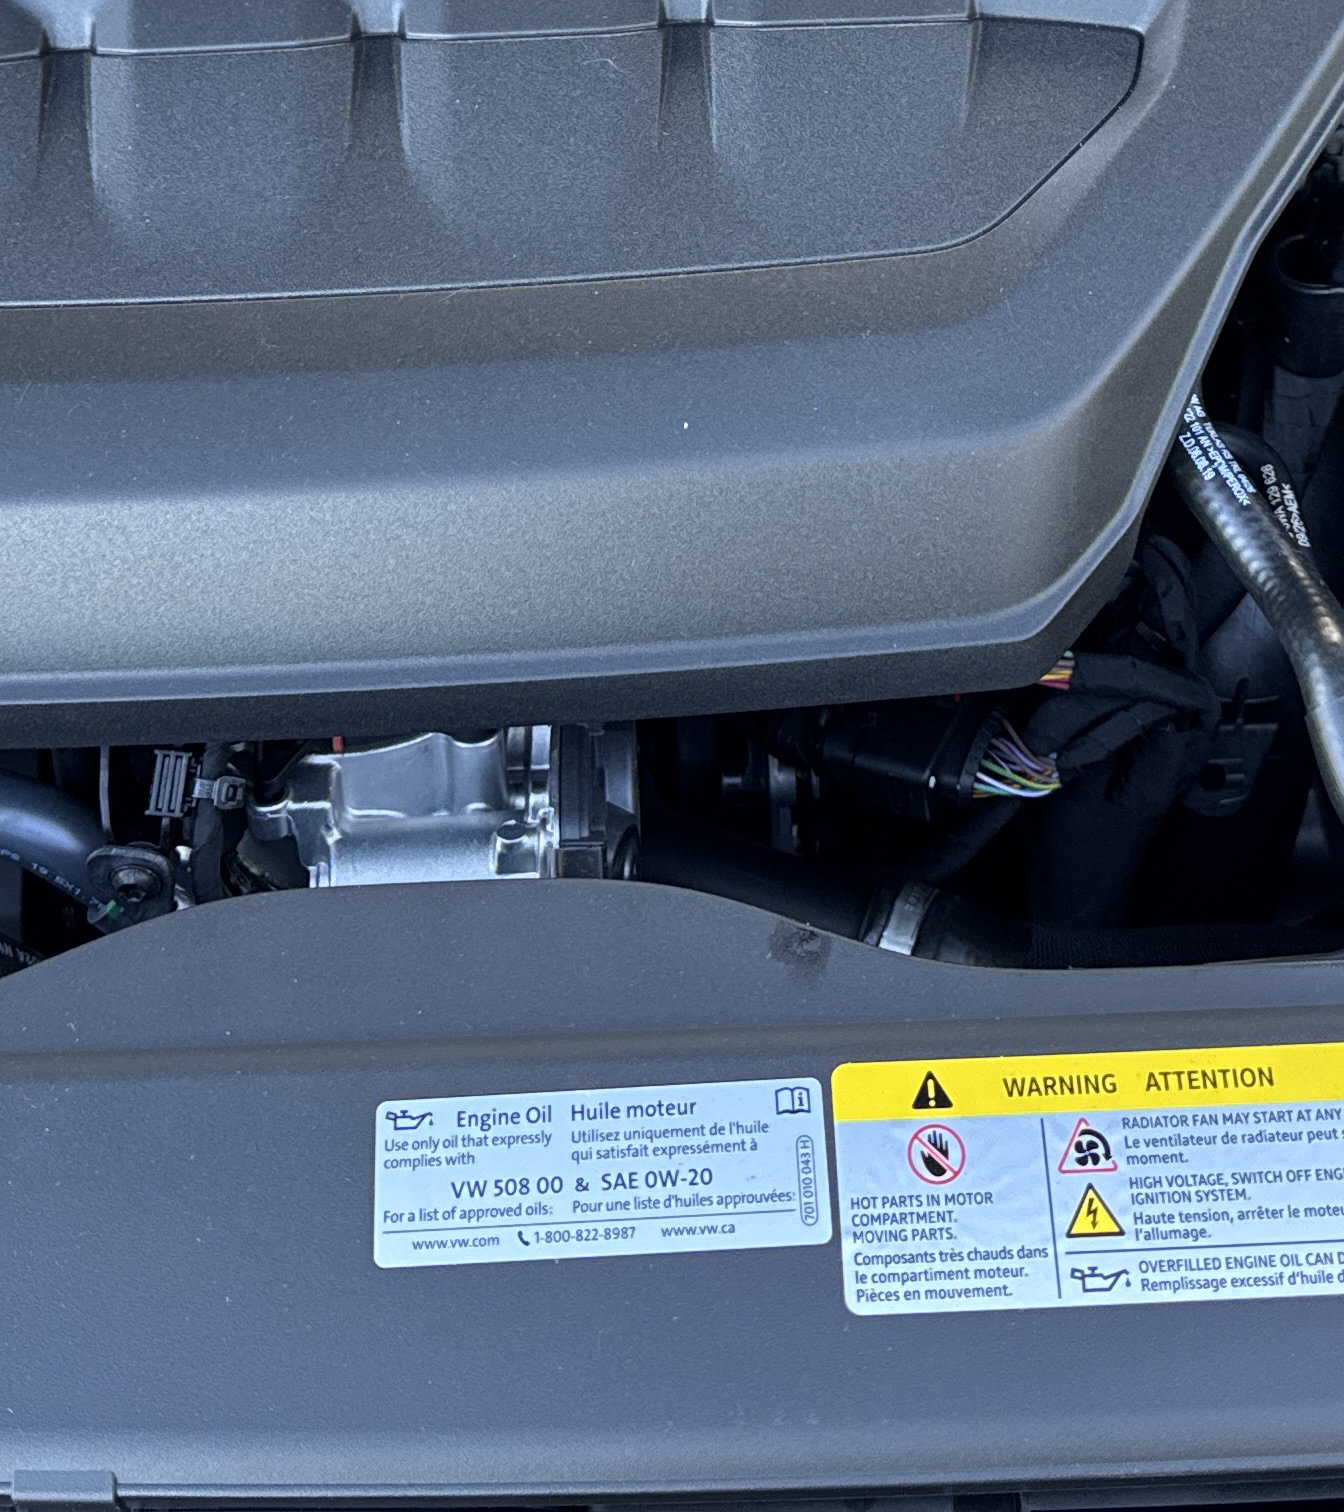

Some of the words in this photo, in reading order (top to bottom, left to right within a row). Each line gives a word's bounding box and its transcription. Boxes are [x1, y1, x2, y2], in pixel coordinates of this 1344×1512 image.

[1003, 1073, 1117, 1097] WARNING
[1146, 1066, 1274, 1091] ATTENTION
[458, 1107, 520, 1131] Engine
[526, 1104, 551, 1123] Oil
[572, 1101, 620, 1121] Huile
[627, 1099, 696, 1118] moteur
[1122, 1114, 1189, 1129] RADIATOR
[1222, 1111, 1249, 1125] MAY
[1253, 1109, 1293, 1124] START
[385, 1138, 409, 1152] Use
[412, 1135, 440, 1153] only
[443, 1134, 458, 1149] oil
[461, 1133, 489, 1147] that
[492, 1129, 552, 1149] expressly
[572, 1128, 620, 1143] Utilisez
[624, 1124, 706, 1143] uniquement
[729, 1119, 769, 1135] l'huile
[1143, 1133, 1217, 1147] ventilateur
[1242, 1129, 1303, 1143] radiateur
[1307, 1127, 1339, 1143] peut
[384, 1150, 442, 1171] complies
[445, 1150, 474, 1165] with
[572, 1146, 592, 1164] qui
[596, 1143, 649, 1159] satisfait
[653, 1138, 746, 1159] expressément
[1126, 1151, 1188, 1165] moment.
[494, 1177, 530, 1197] 508
[601, 1171, 638, 1190] SAE
[645, 1167, 712, 1188] 0W-20
[1129, 1175, 1163, 1189] HIGH
[1165, 1172, 1228, 1187] VOLTAGE,
[1231, 1169, 1282, 1185] SWITCH
[1286, 1168, 1311, 1182] OFF
[573, 1199, 604, 1214] Pour
[634, 1195, 660, 1210] liste
[664, 1192, 713, 1208] d'huiles
[882, 1194, 923, 1208] PARTS
[945, 1191, 993, 1205] MOTOR
[1131, 1190, 1191, 1205] IGNITION
[1195, 1187, 1251, 1202] SYSTEM.
[420, 1207, 439, 1221] list
[459, 1202, 521, 1223] approved
[526, 1201, 552, 1215] oils:
[852, 1210, 957, 1227] COMPARTMENT.
[1133, 1211, 1175, 1225] Haute
[1178, 1207, 1233, 1223] tension,
[1238, 1205, 1284, 1220] arrêter
[534, 1226, 635, 1243] 1-800-822-8987
[661, 1223, 735, 1237] www.vw.ca
[853, 1228, 908, 1243] MOVING
[912, 1226, 957, 1241] PARTS.
[1135, 1226, 1211, 1242] l'allumage.
[412, 1236, 499, 1250] www.vw.com
[854, 1250, 936, 1268] Composants
[939, 1247, 964, 1262] très
[967, 1245, 1014, 1261] chauds
[1017, 1244, 1048, 1259] dans
[1139, 1256, 1221, 1273] OVERFILLED
[1225, 1254, 1277, 1269] ENGINE
[1280, 1253, 1303, 1267] OIL
[1305, 1252, 1334, 1266] CAN
[871, 1267, 970, 1285] compartiment
[974, 1265, 1028, 1279] moteur.
[1141, 1275, 1227, 1293] Remplissage
[1231, 1271, 1284, 1288] excessif
[1288, 1269, 1333, 1285] d'huile
[857, 1287, 900, 1302] Pièces
[925, 1284, 1013, 1299] mouvement.
